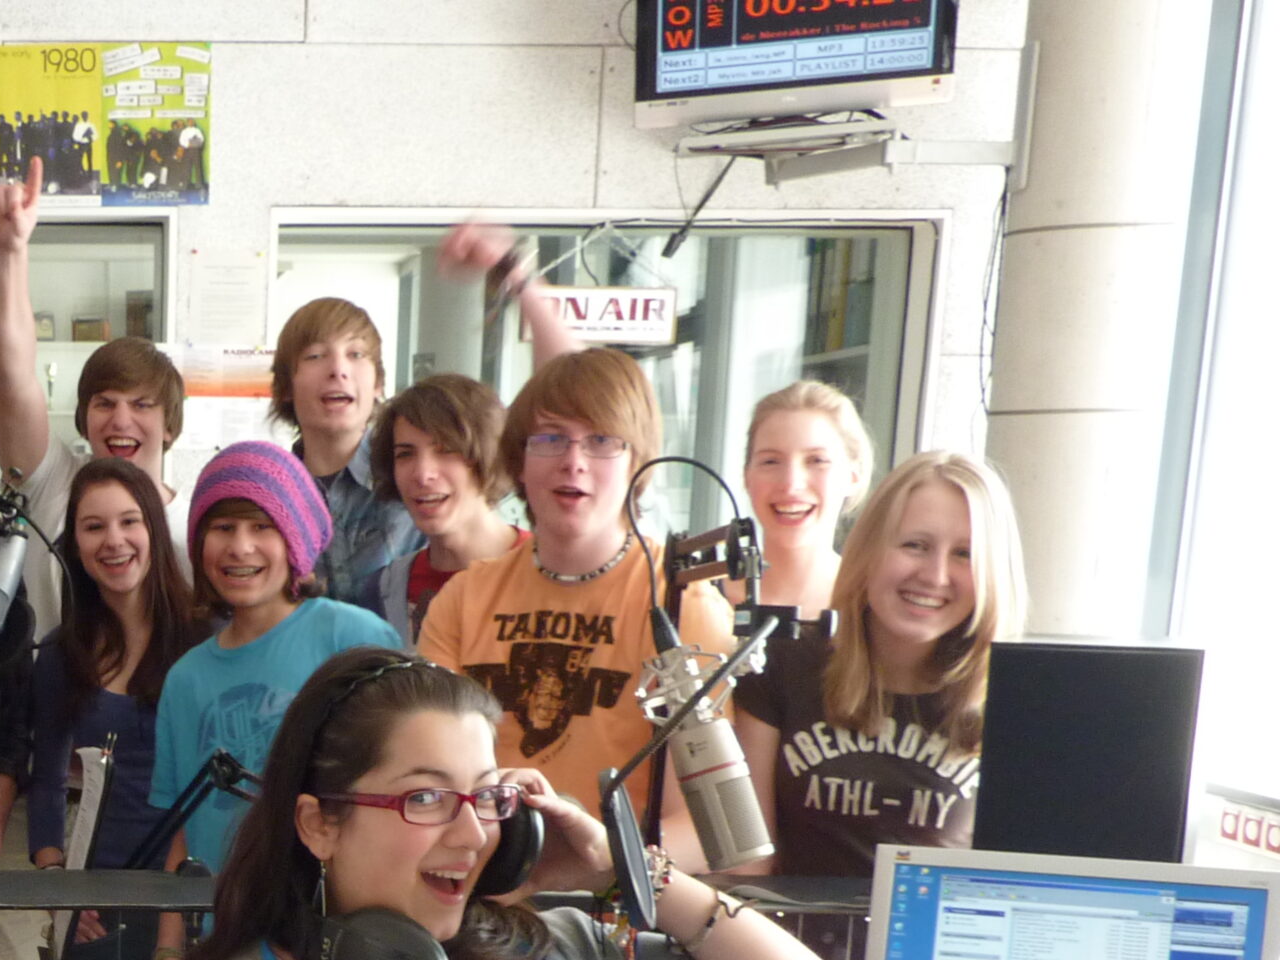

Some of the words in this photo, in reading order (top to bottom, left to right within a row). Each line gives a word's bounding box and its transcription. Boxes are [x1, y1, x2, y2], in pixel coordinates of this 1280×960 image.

[40, 47, 97, 73] 1980
[800, 59, 858, 72] PLAYLIST
[598, 297, 666, 321] AIR
